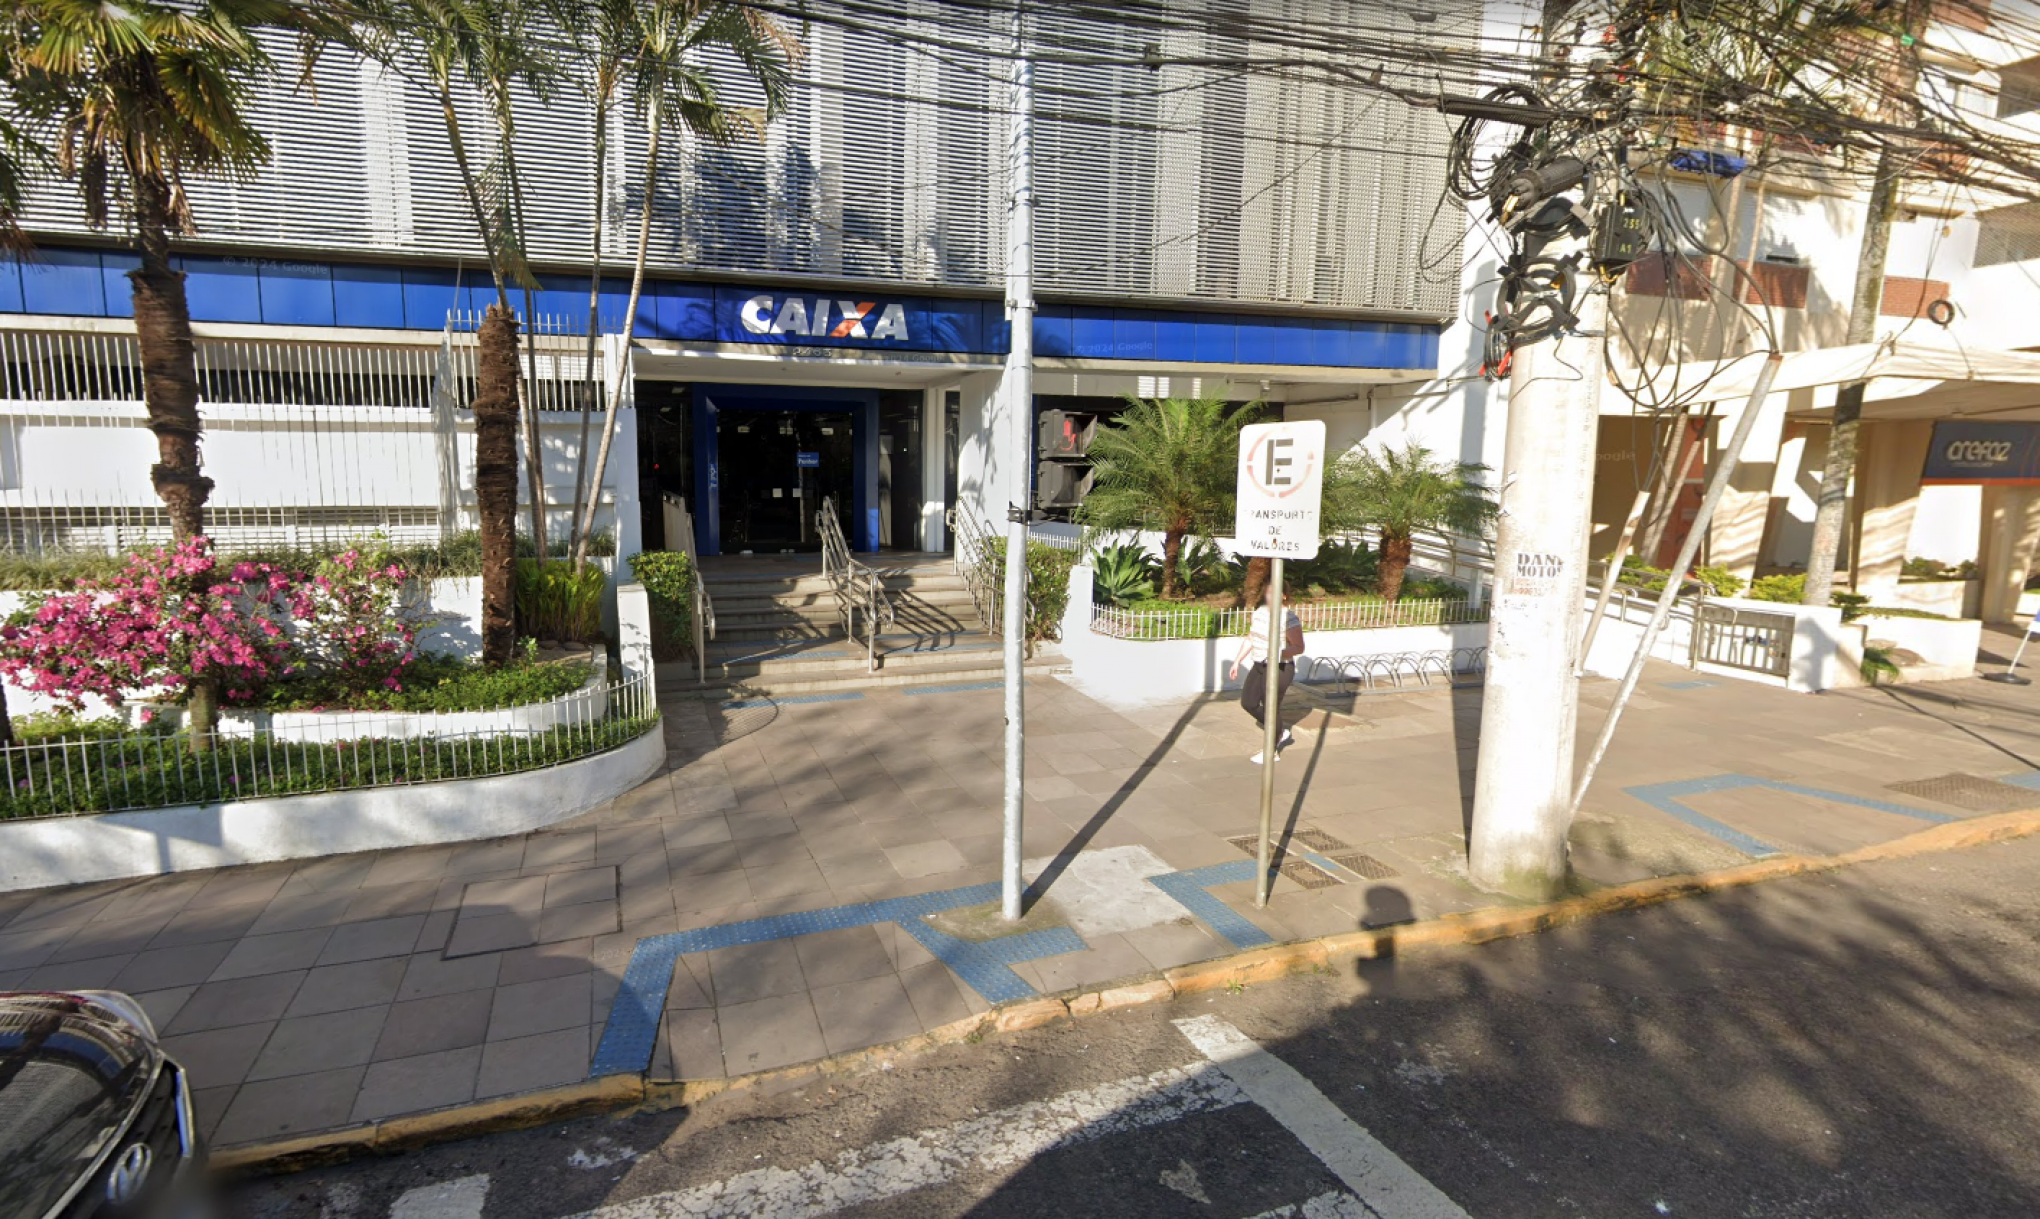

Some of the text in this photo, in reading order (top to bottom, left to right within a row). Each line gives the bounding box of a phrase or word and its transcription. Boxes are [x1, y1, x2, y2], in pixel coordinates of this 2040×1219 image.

[740, 295, 910, 341] CAIXA
[1265, 438, 1294, 486] E
[1268, 525, 1283, 536] DE
[1250, 540, 1300, 552] VALORES
